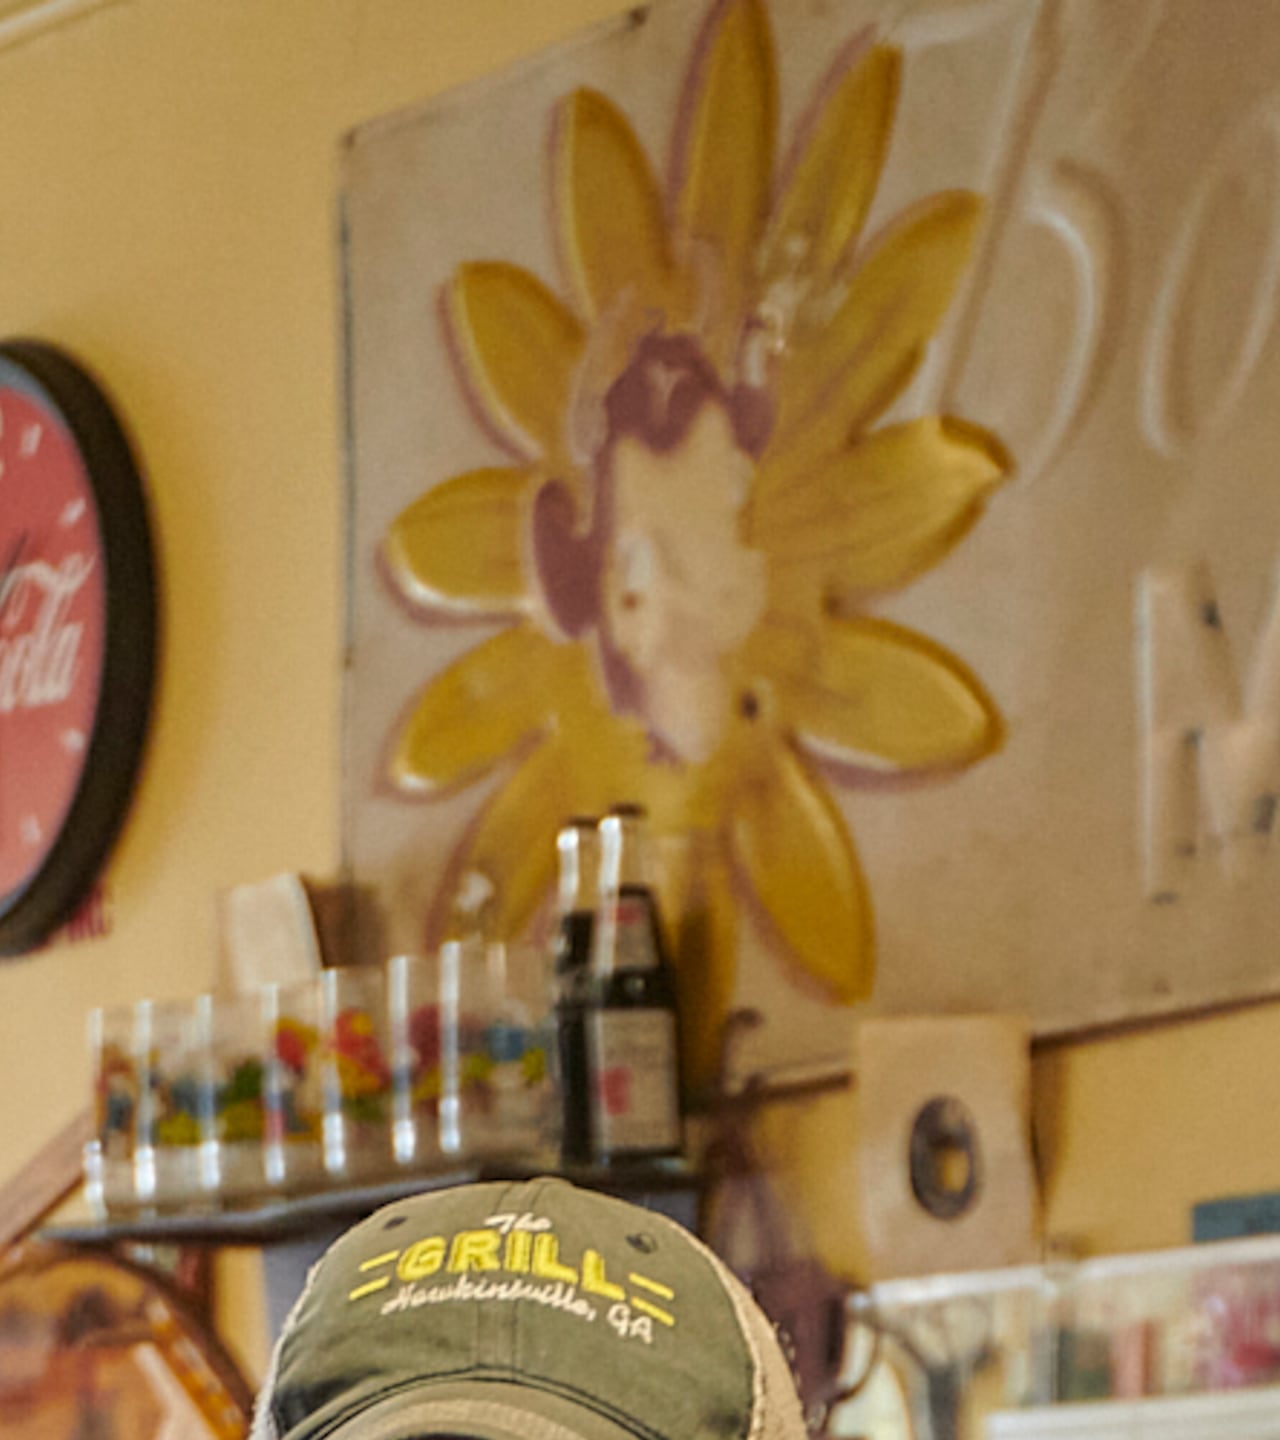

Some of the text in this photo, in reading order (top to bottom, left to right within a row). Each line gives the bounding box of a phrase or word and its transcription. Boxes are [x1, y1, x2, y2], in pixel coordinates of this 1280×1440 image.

[484, 1212, 552, 1236] The
[396, 1229, 625, 1302] GRILL
[605, 1303, 653, 1345] GA
